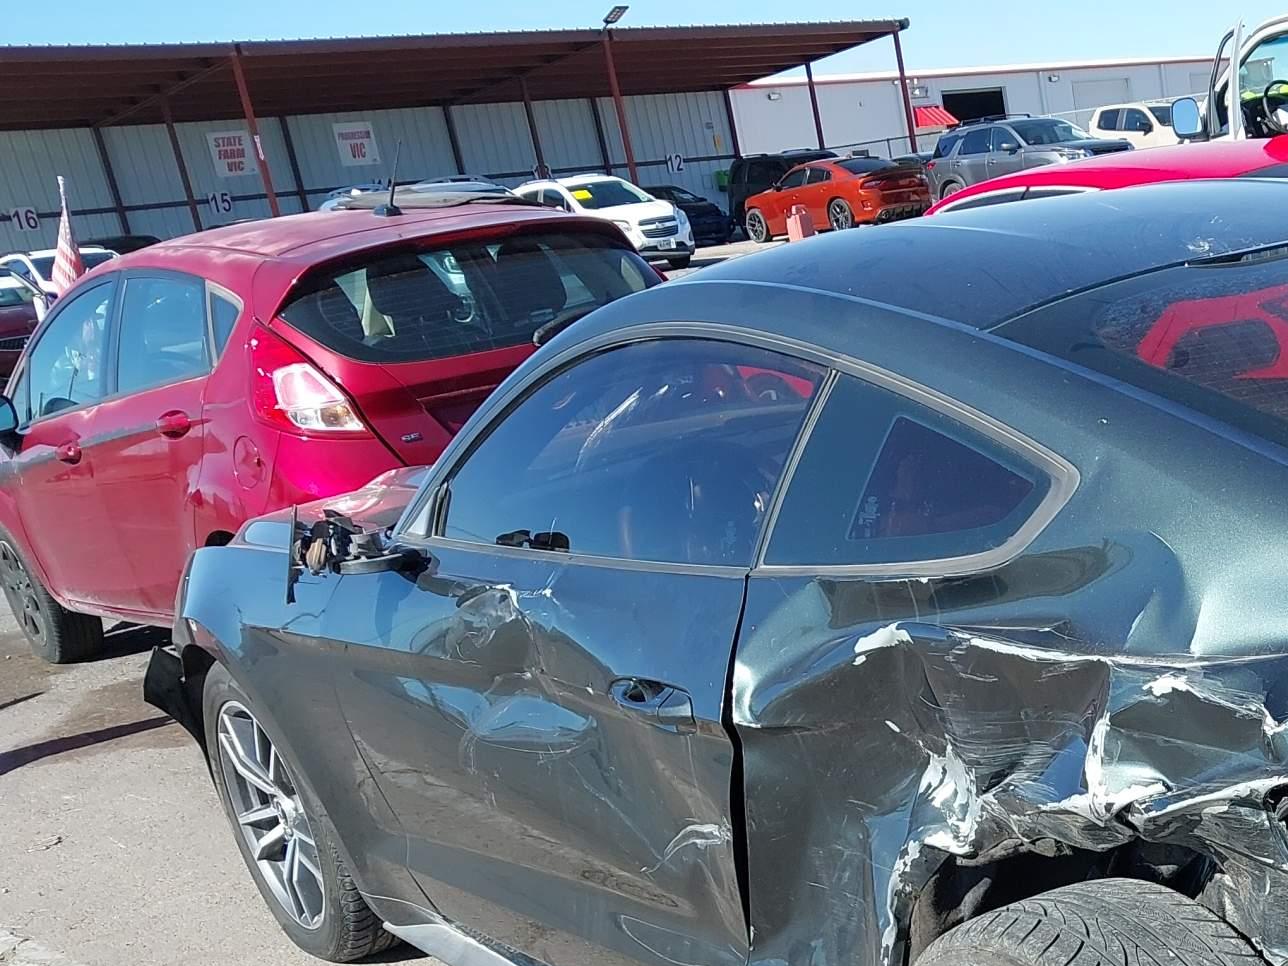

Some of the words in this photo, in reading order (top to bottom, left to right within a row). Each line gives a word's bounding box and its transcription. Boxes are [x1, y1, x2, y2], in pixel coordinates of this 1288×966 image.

[214, 136, 243, 148] STATE
[218, 148, 245, 160] FARM
[350, 142, 366, 159] VIC
[227, 161, 245, 172] VIC
[668, 155, 684, 171] 12
[210, 193, 232, 213] 15
[12, 209, 38, 230] 16
